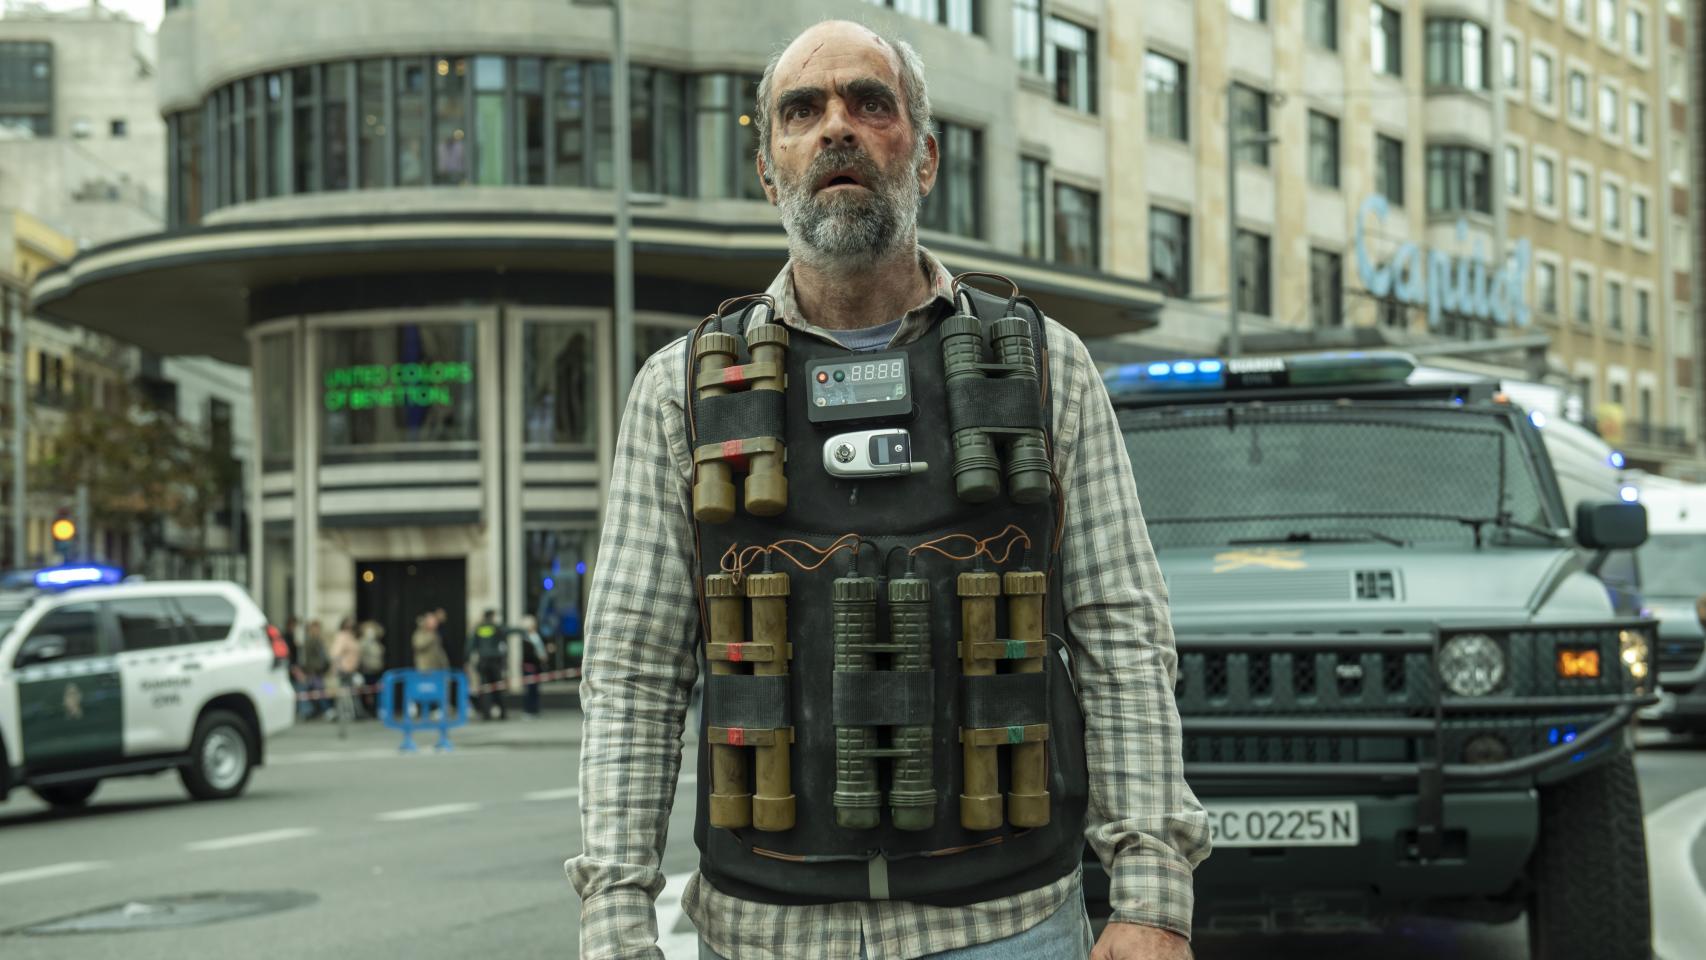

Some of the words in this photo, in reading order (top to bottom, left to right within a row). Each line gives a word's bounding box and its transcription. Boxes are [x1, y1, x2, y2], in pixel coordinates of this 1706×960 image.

[325, 366, 388, 388] UNITED
[390, 361, 474, 385] COLORS
[324, 388, 346, 412] OF
[349, 384, 453, 411] BENETTON
